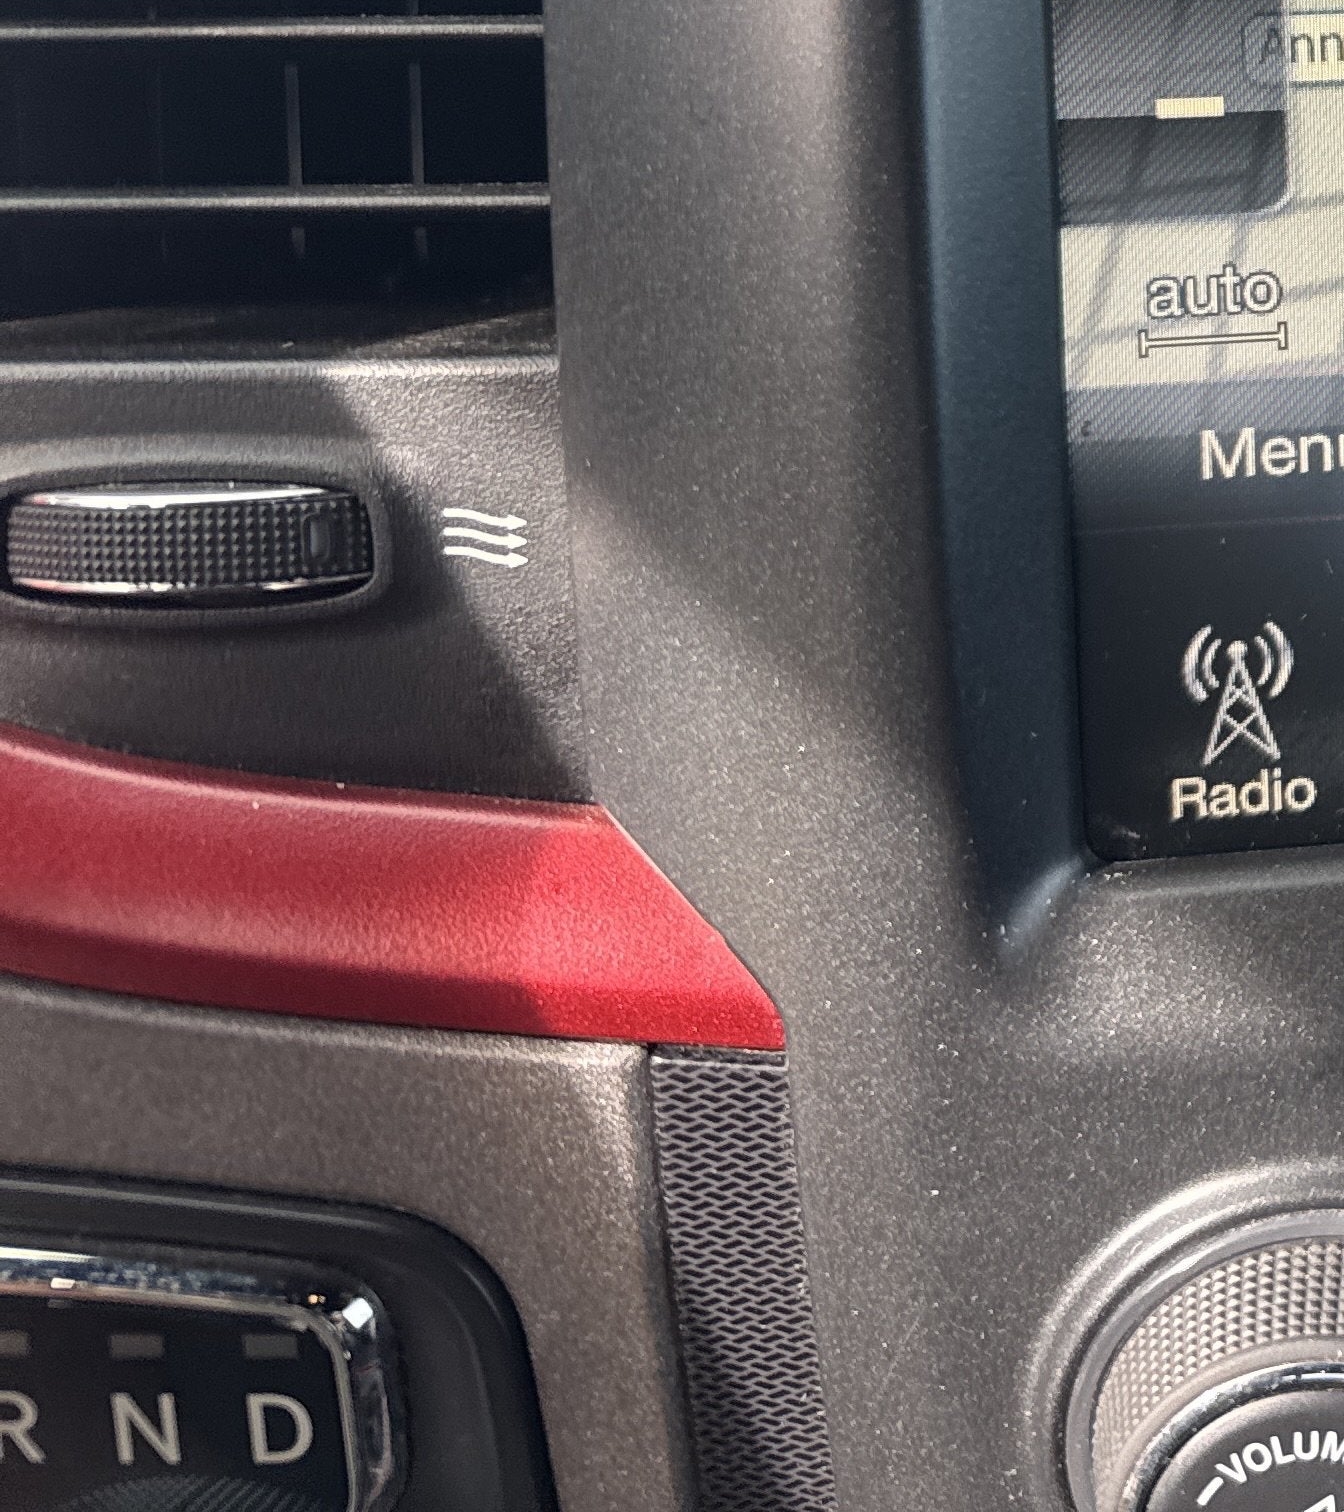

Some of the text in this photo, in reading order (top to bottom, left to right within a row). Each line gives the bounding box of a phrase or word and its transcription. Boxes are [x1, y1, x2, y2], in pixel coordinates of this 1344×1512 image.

[1260, 28, 1344, 64] Ann
[1145, 262, 1283, 320] auto
[1168, 768, 1318, 822] Radio
[0, 1390, 314, 1467] R N D
